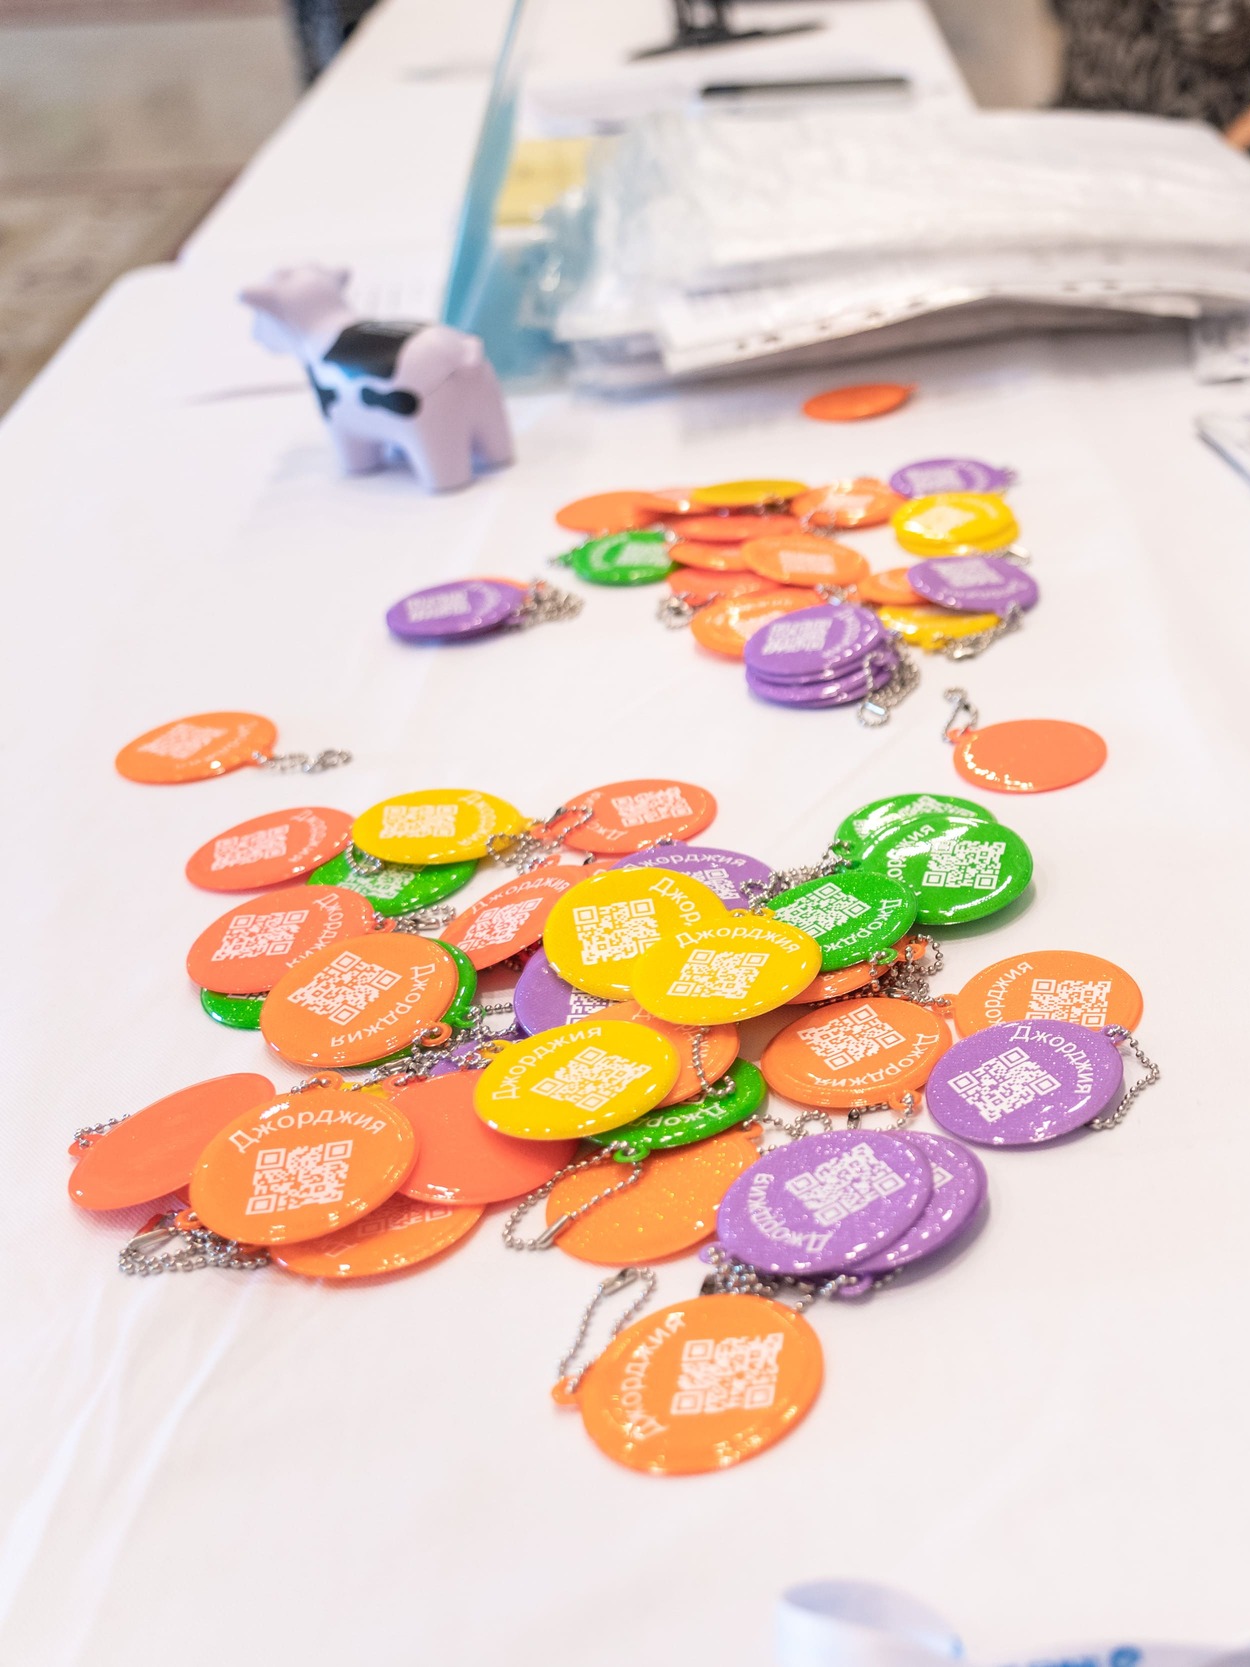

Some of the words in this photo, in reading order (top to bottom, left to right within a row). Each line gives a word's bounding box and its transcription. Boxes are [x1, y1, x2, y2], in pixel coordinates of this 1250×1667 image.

[472, 877, 570, 914] Джорджия
[648, 877, 701, 926] Джор
[675, 926, 800, 954] Джорджия
[823, 899, 902, 953] Джордж
[330, 963, 436, 1047] Джорджия
[492, 1025, 603, 1101] Джорджия
[813, 1032, 939, 1086] Джорджия
[1009, 1025, 1094, 1095] Джорджия
[228, 1108, 386, 1153] Джорджия
[749, 1173, 834, 1253] Джорджия
[618, 1311, 686, 1441] Джорджия
